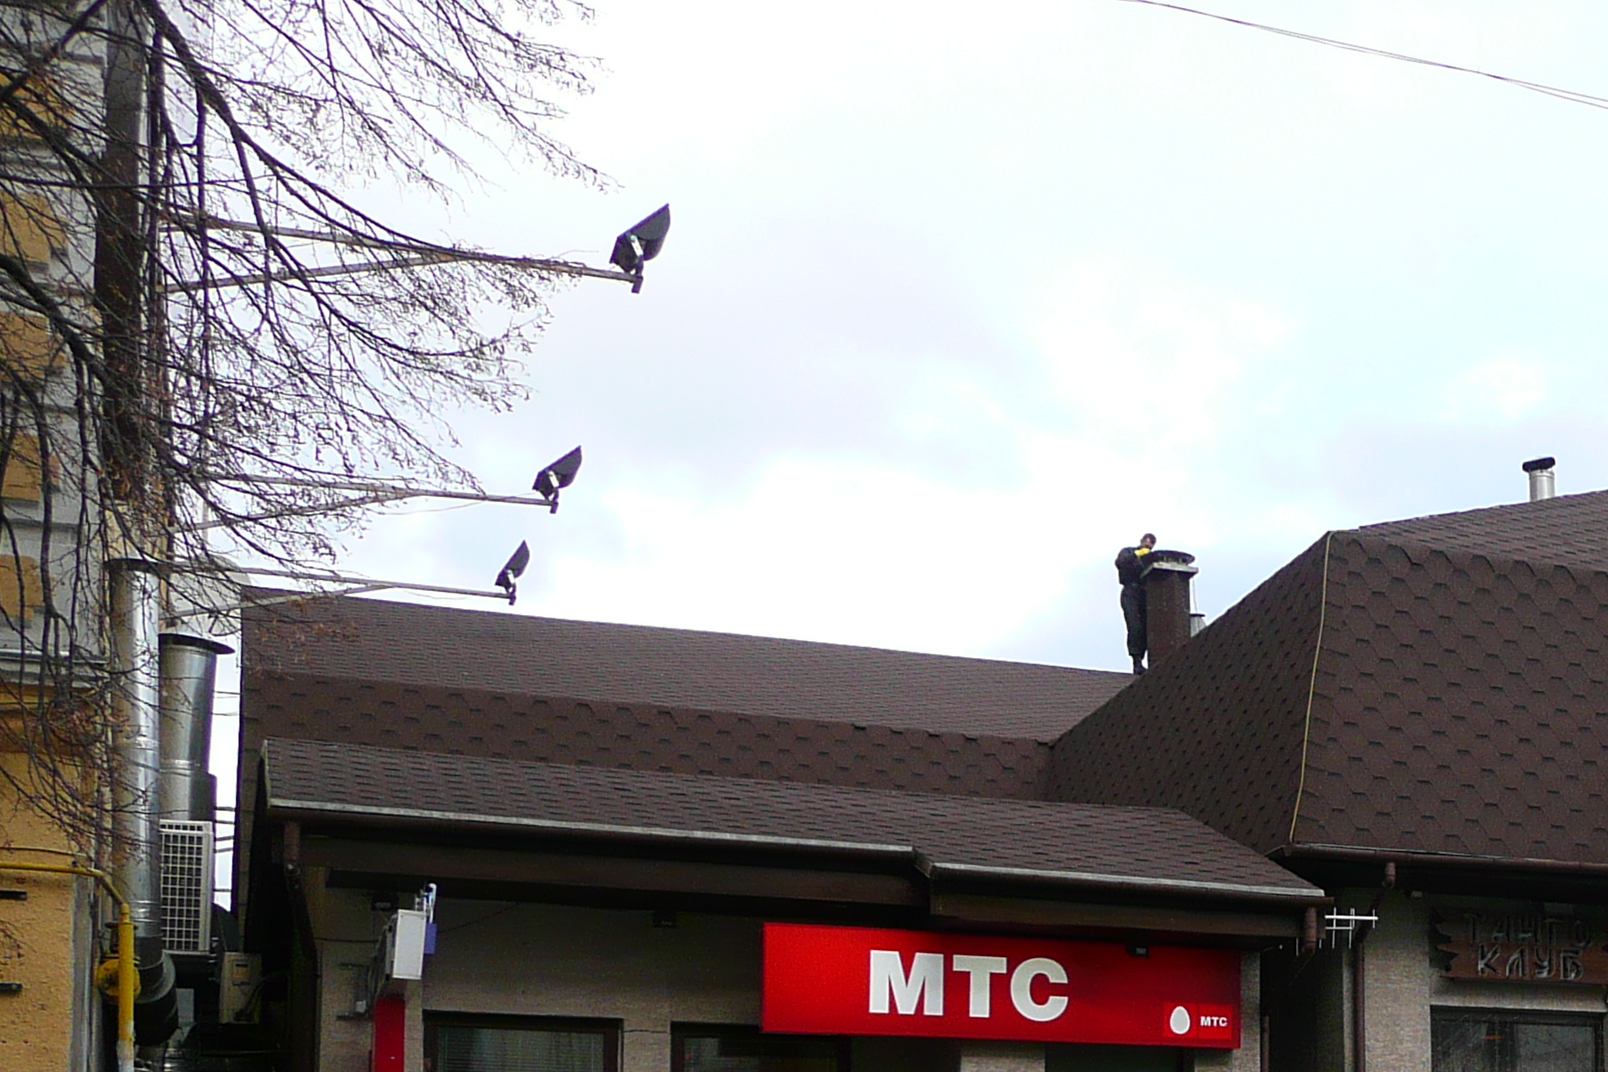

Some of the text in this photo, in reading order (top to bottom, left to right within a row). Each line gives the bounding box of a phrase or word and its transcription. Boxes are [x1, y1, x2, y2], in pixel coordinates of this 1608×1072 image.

[1478, 944, 1585, 981] КЛУБ
[869, 949, 1068, 1022] МТС
[1200, 1015, 1228, 1028] МТС
